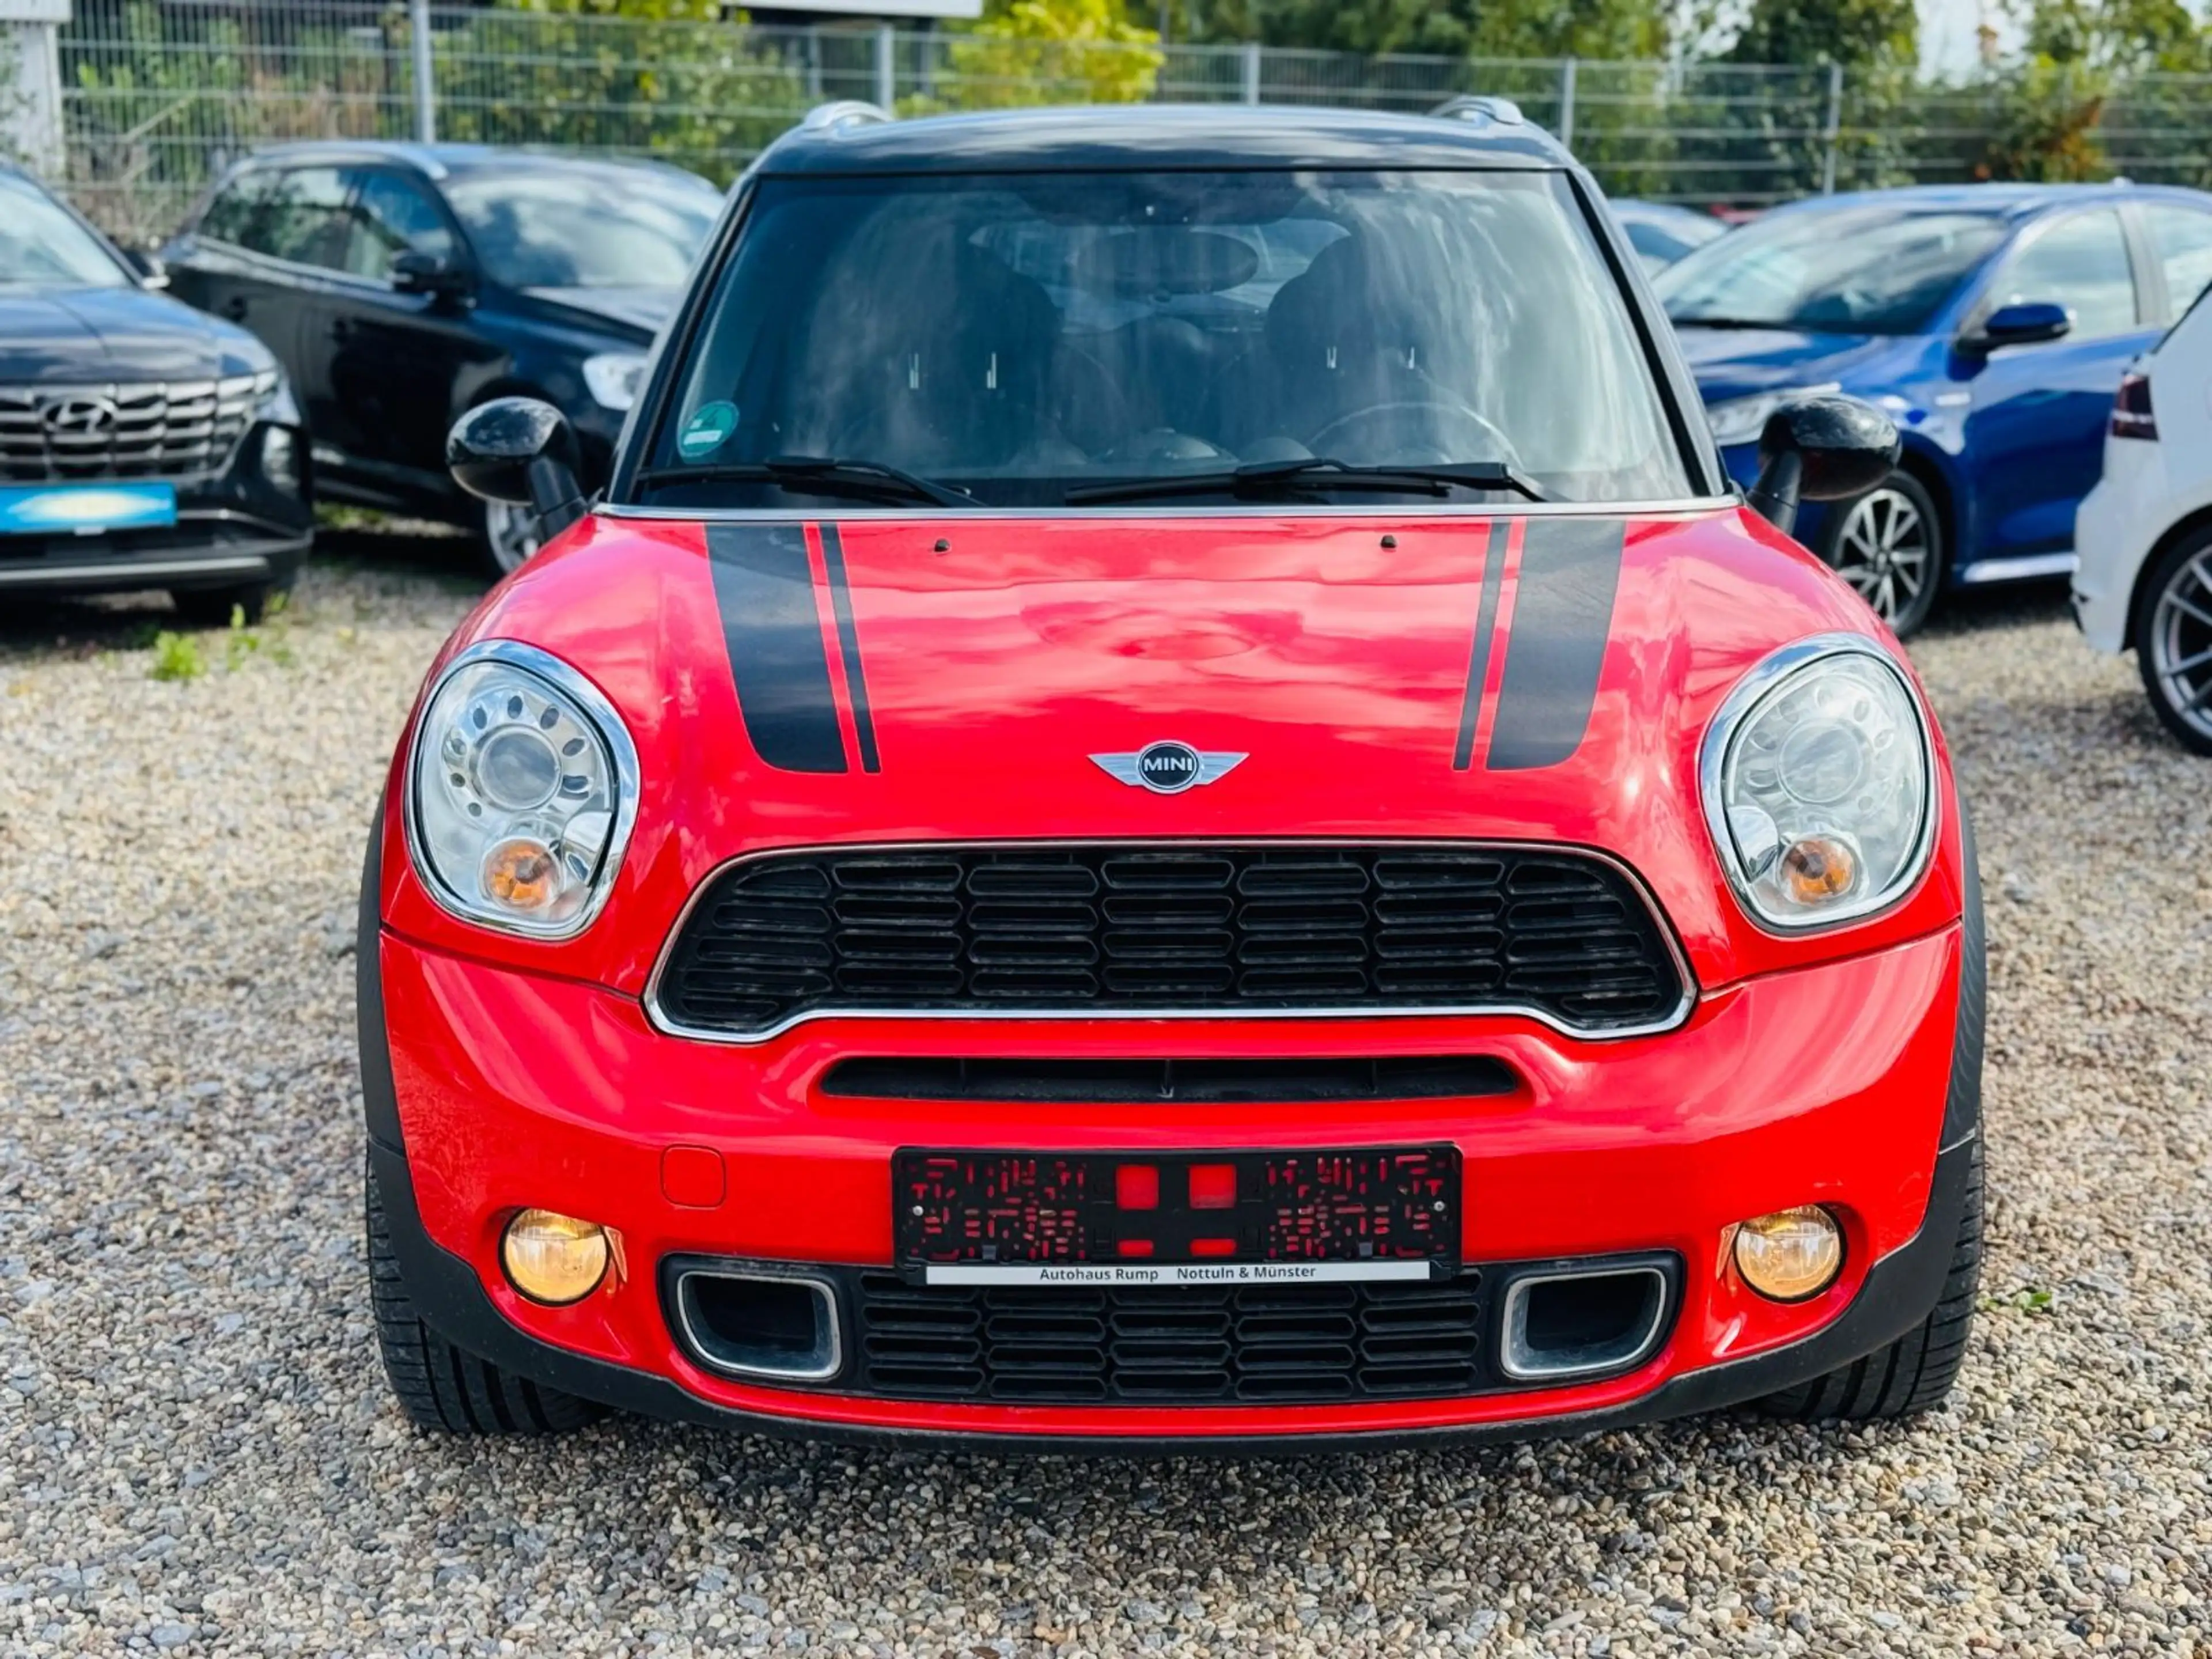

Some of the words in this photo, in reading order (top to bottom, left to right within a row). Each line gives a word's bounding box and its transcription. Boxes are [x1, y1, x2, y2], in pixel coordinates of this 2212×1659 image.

[1145, 757, 1192, 771] MINI
[1040, 1268, 1111, 1281] Autohaus
[1116, 1268, 1158, 1282] Rump
[1177, 1267, 1235, 1279] Nottuln
[1238, 1267, 1249, 1278] &
[1255, 1266, 1316, 1278] Münster
